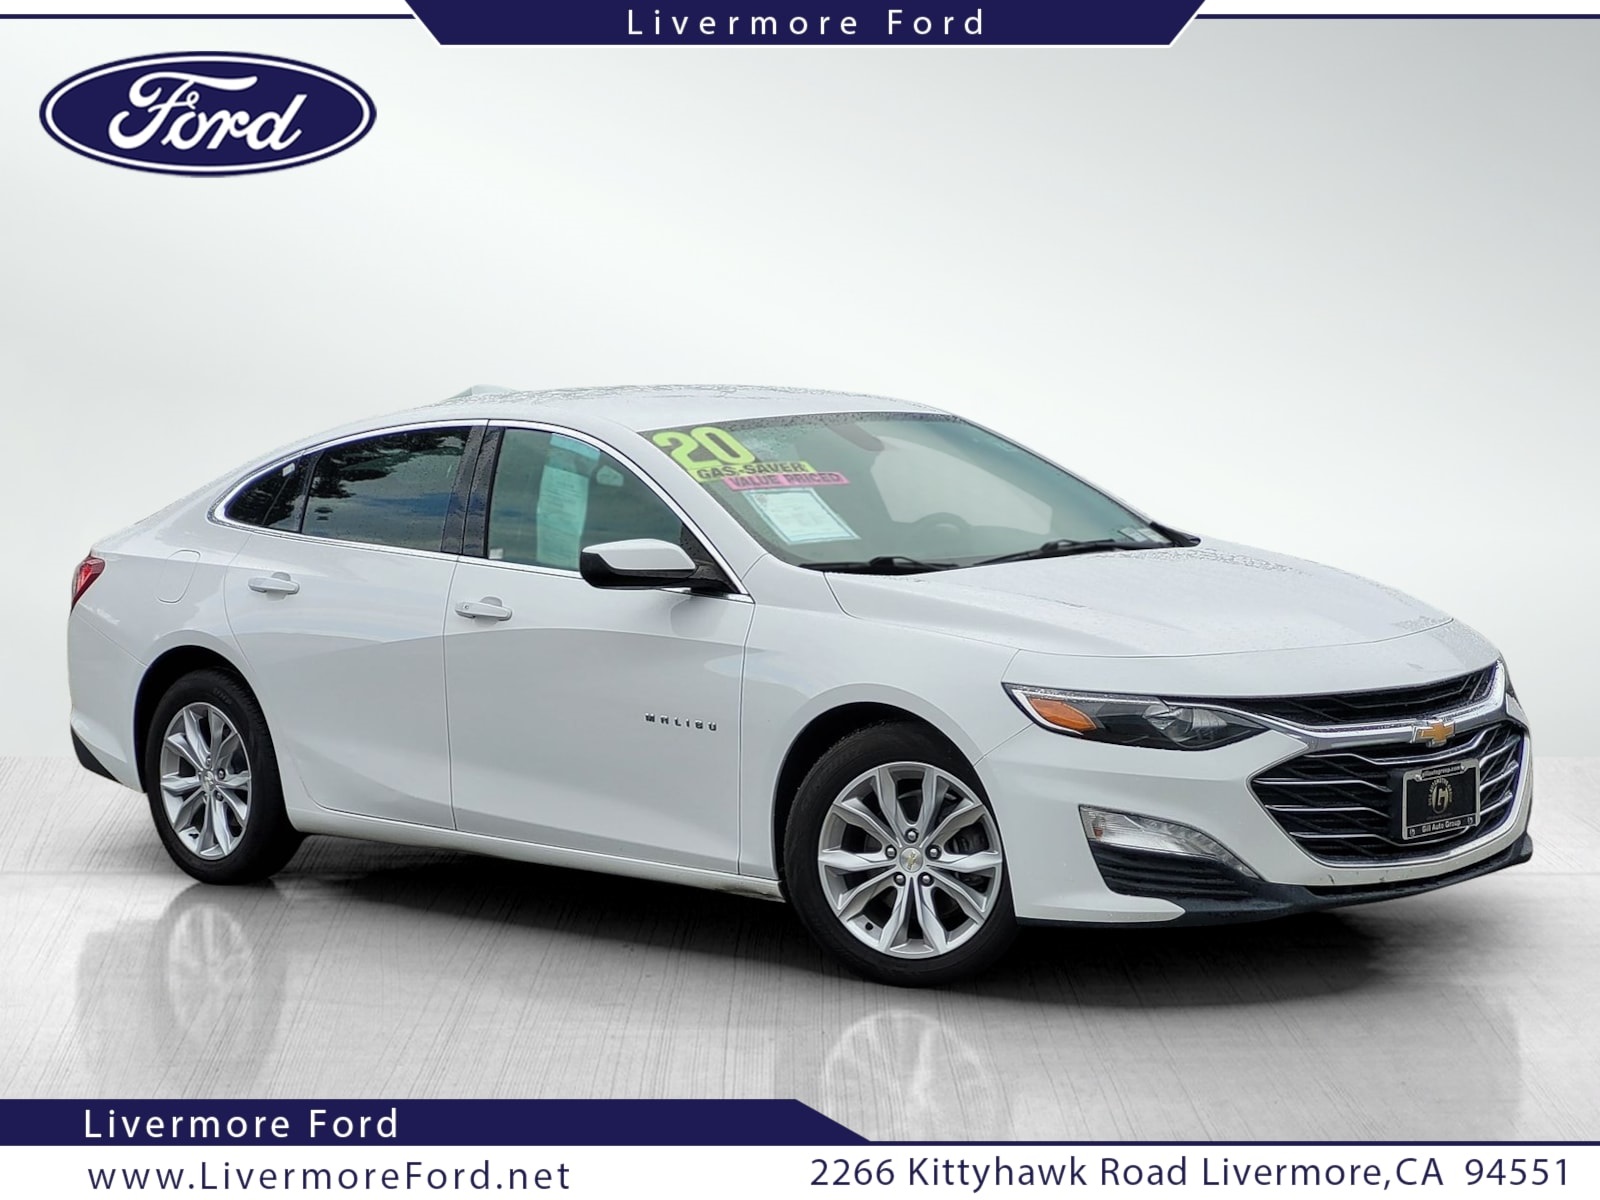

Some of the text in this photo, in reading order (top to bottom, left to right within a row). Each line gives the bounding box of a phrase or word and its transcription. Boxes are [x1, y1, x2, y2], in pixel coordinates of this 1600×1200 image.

[652, 426, 755, 470] 20
[727, 472, 843, 488] VALUE PRICED
[645, 713, 717, 731] MALIBU
[1432, 822, 1444, 831] Auto
